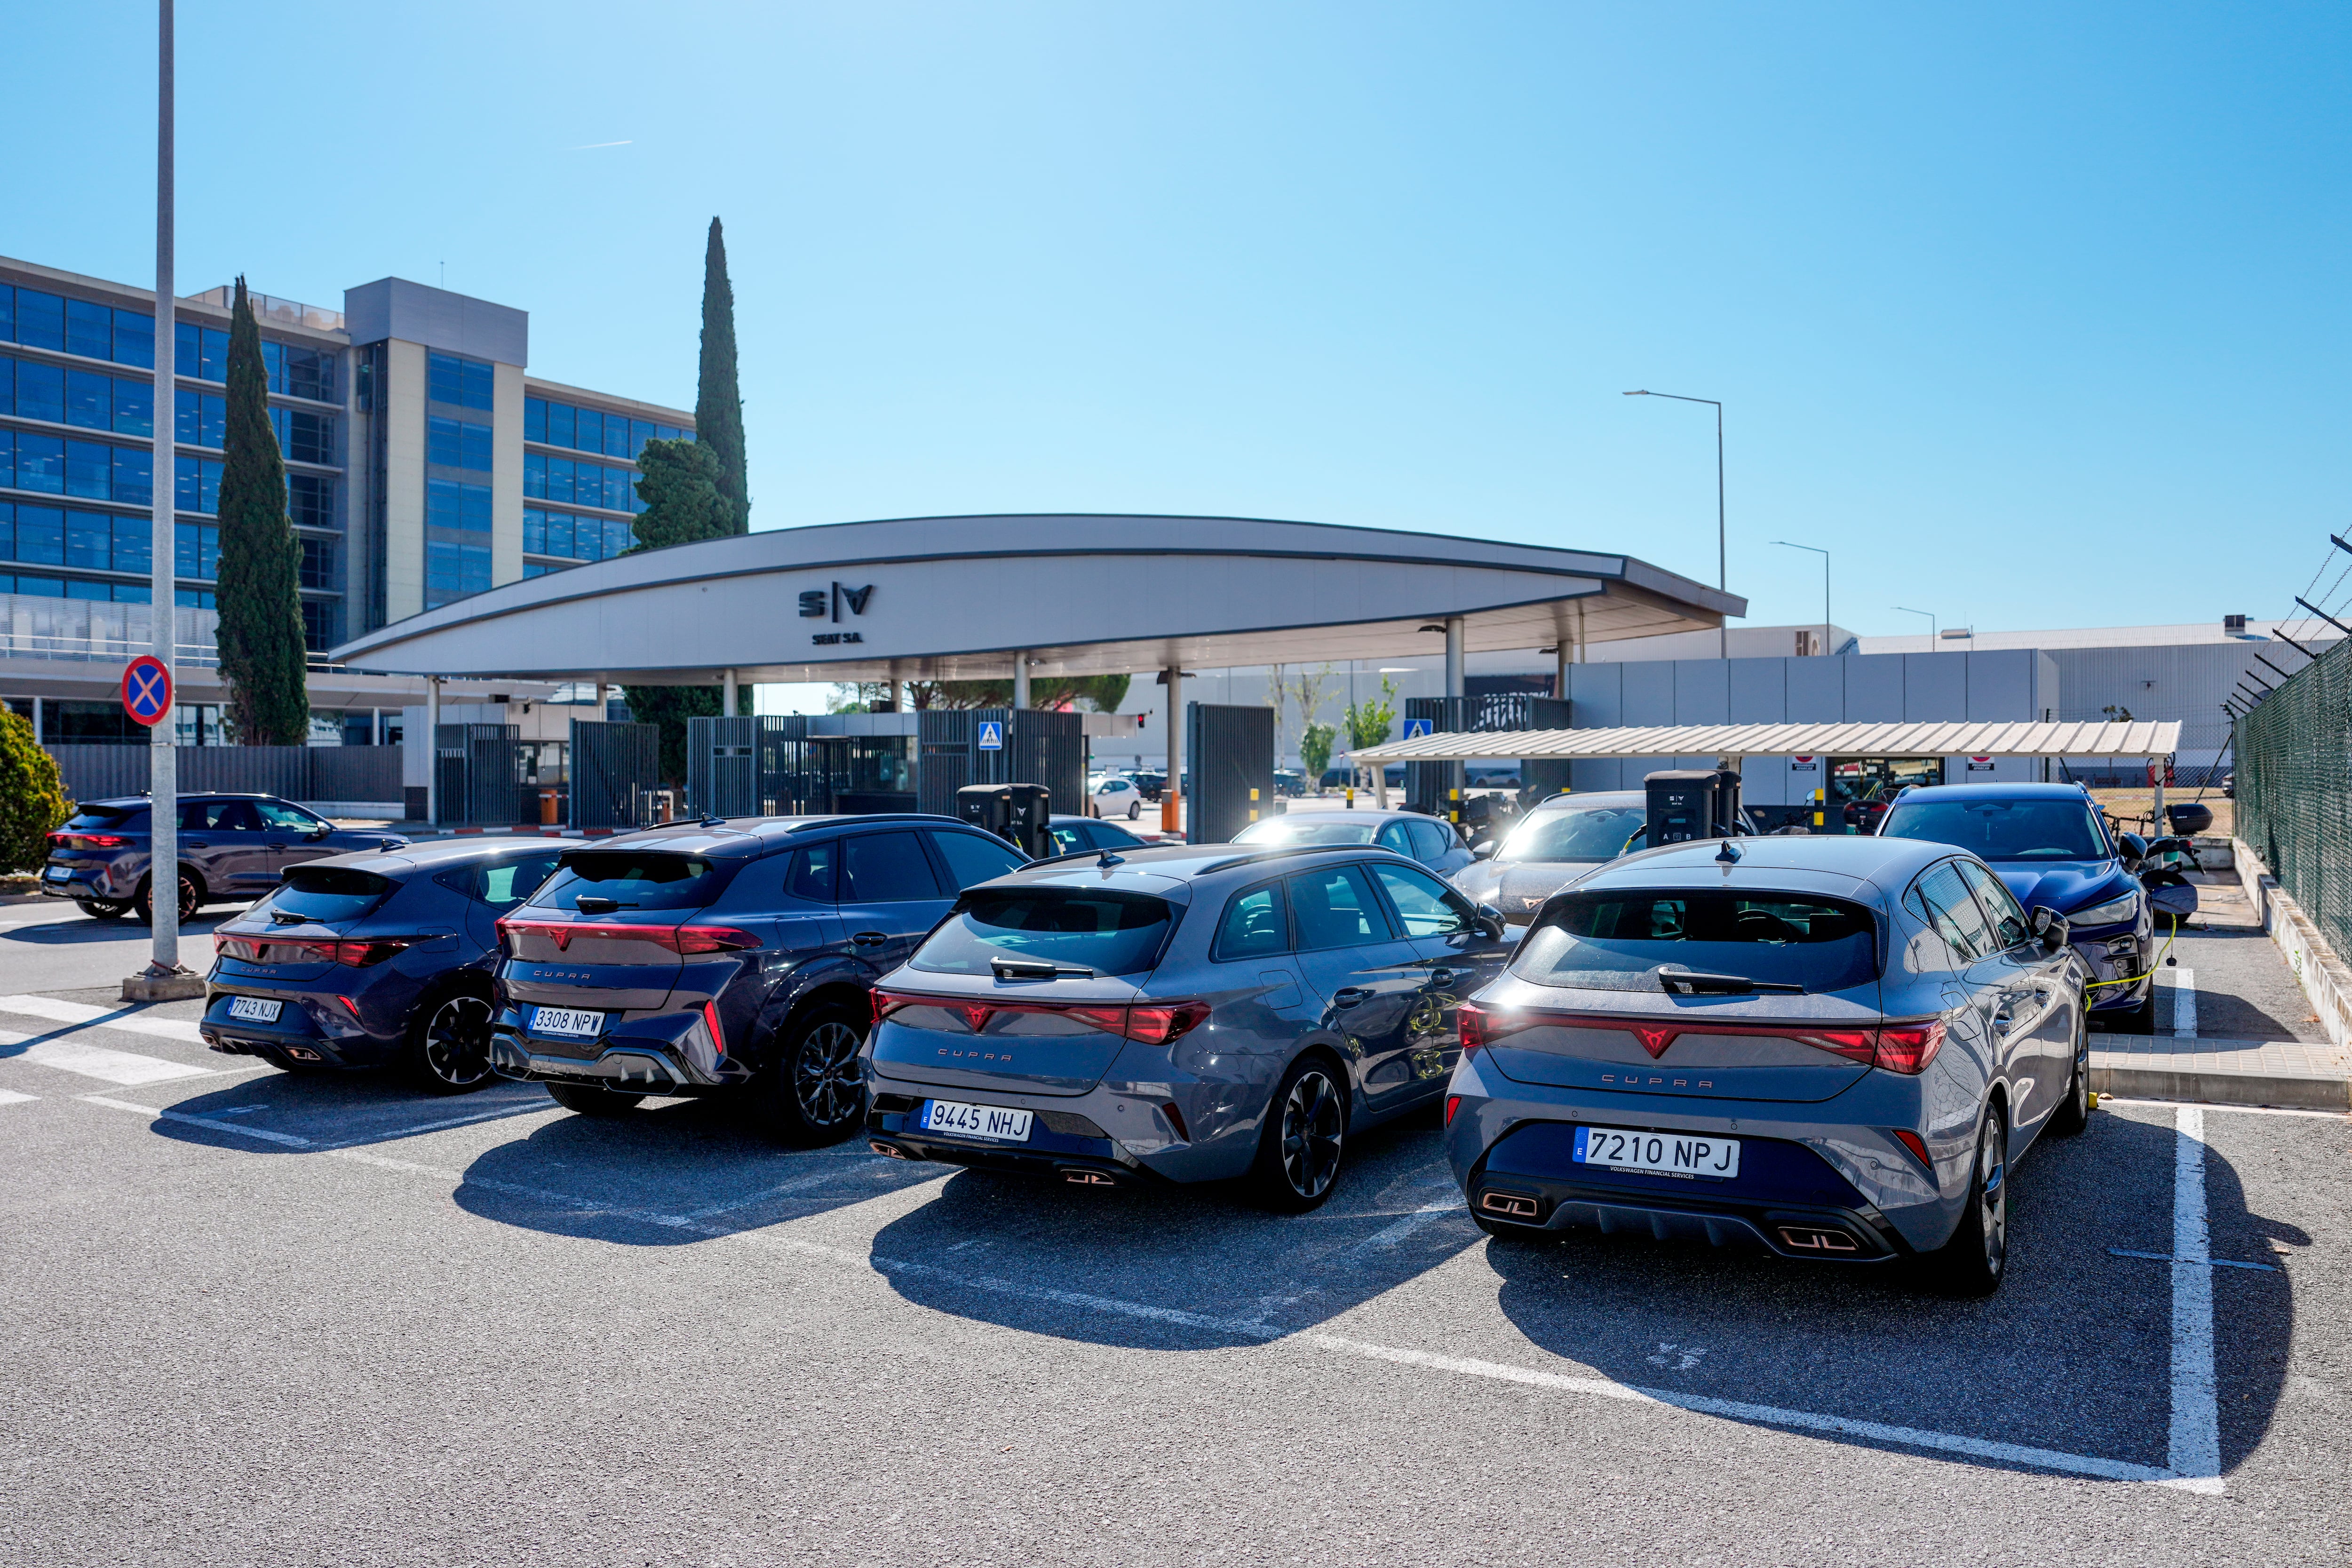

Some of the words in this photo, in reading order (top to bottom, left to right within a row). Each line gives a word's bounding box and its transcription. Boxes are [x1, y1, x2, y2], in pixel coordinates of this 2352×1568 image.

[812, 633, 841, 645] SEAT
[534, 971, 591, 979] CUPRA
[233, 1000, 257, 1015] 7743
[258, 1003, 279, 1019] NJX
[536, 1011, 570, 1028] 3308
[572, 1014, 601, 1032] NPW
[938, 1049, 1012, 1061] CUPRA
[1602, 1075, 1712, 1088] CUPRA
[933, 1105, 980, 1130] 9445
[987, 1111, 1027, 1136] NHJ
[1590, 1133, 1662, 1163] 7210
[1674, 1140, 1731, 1171] NPJ
